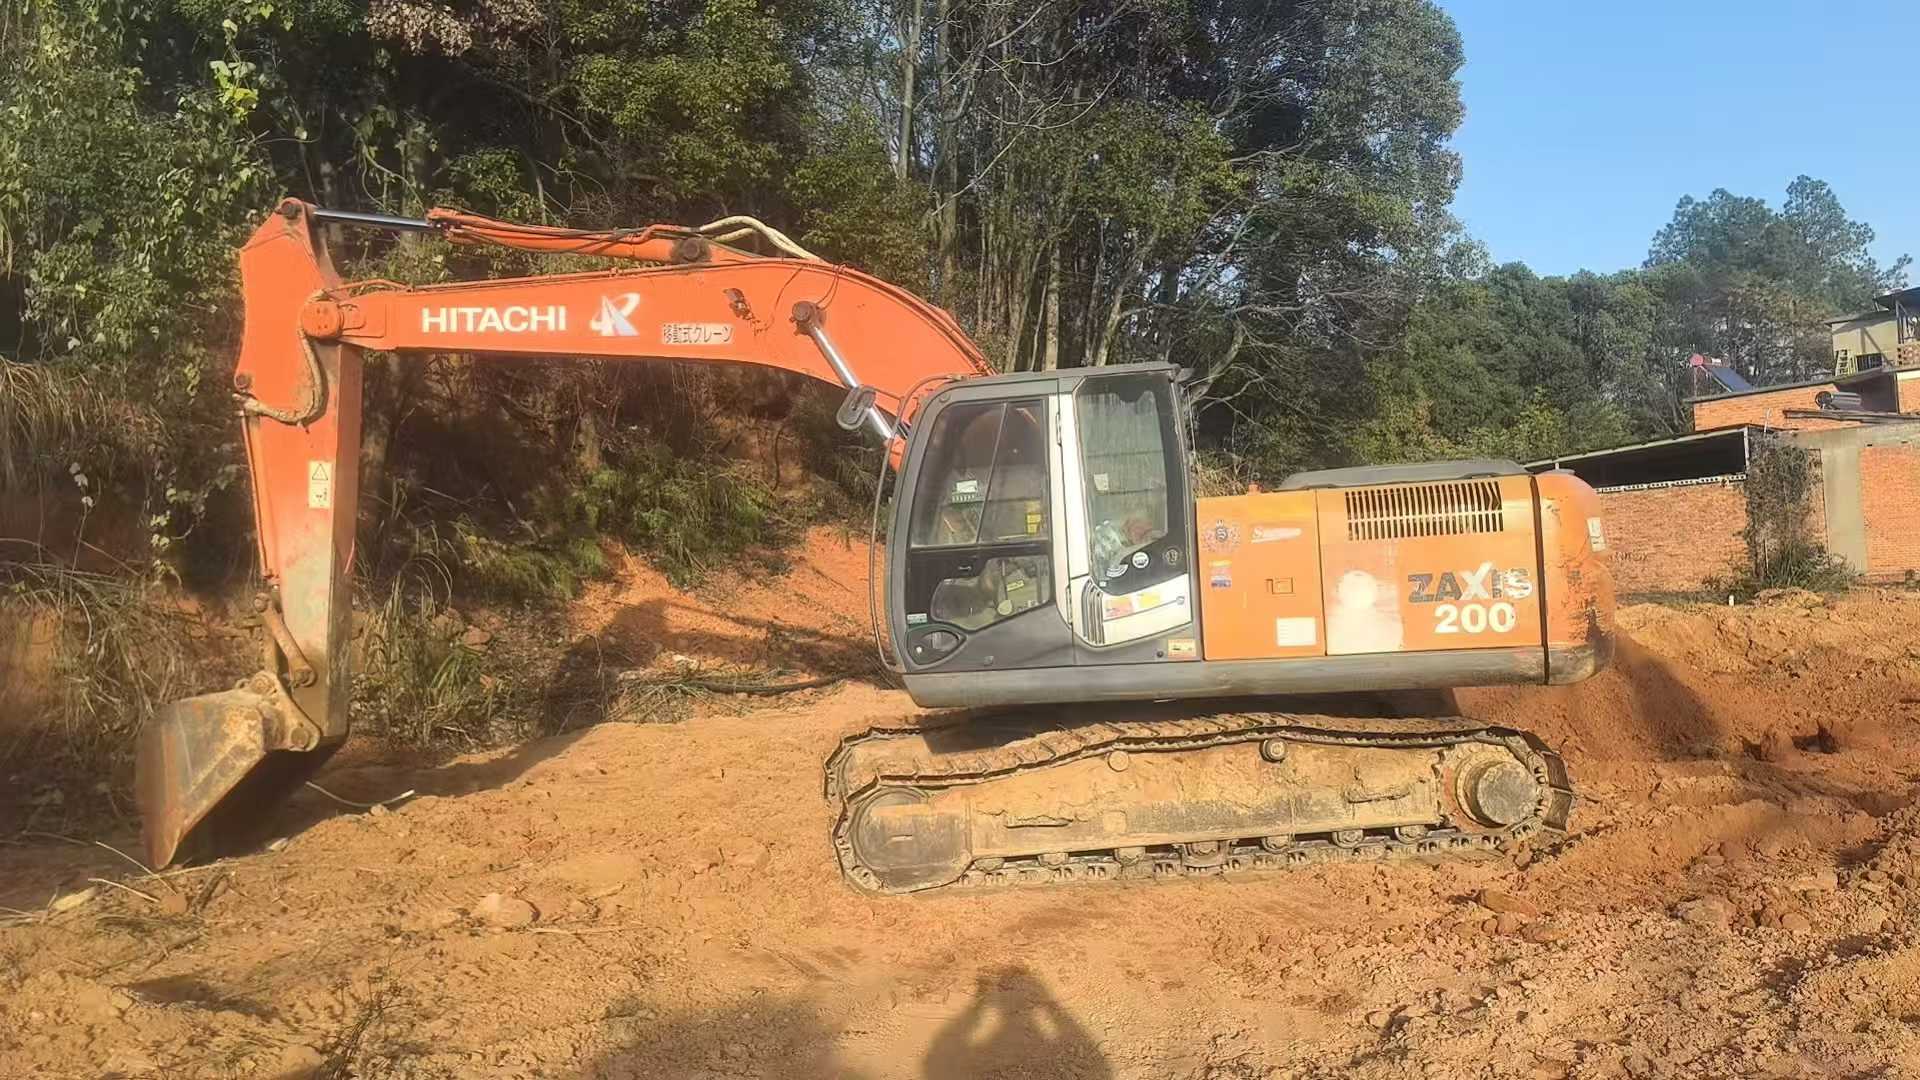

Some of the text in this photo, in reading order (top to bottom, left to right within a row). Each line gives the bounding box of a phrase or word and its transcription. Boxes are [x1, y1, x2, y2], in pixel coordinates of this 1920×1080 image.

[421, 306, 568, 333] HITACHI
[1407, 561, 1532, 603] ZAXIS
[1435, 602, 1516, 633] 200
